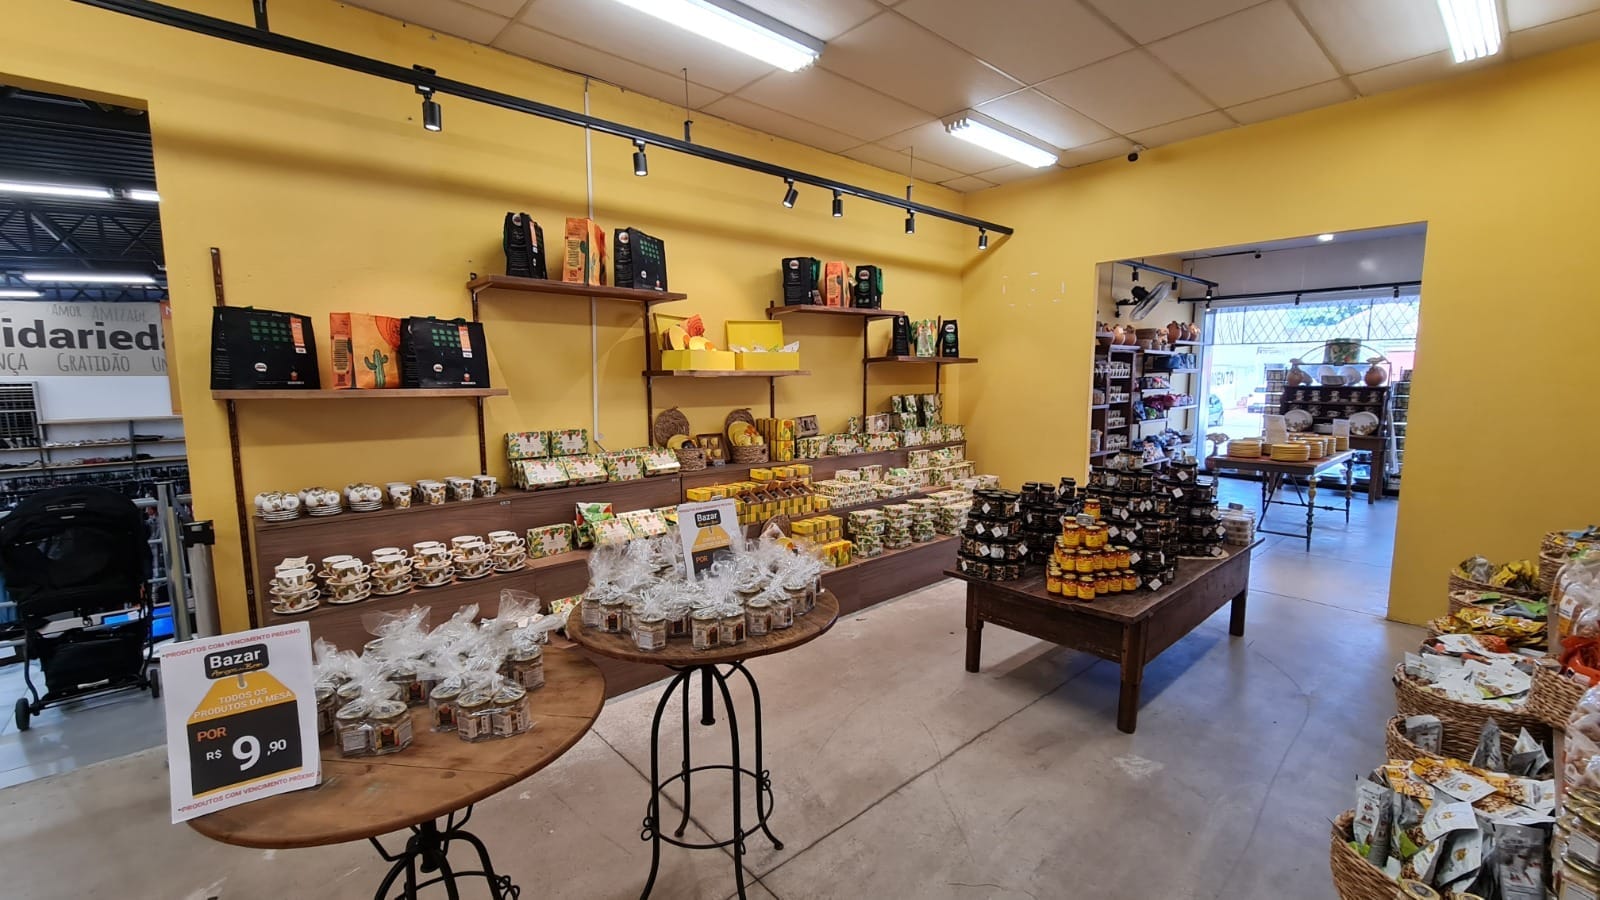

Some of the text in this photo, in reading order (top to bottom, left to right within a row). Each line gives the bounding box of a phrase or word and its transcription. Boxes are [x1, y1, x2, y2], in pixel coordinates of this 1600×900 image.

[2, 318, 165, 350] idaried
[57, 352, 130, 372] GRATIDÃO
[696, 512, 718, 522] Bazar
[208, 642, 225, 651] COM
[225, 632, 270, 647] VENCIMENTO
[209, 649, 262, 669] Bazar
[193, 690, 293, 719] PRODUTOS DA MESA
[219, 687, 268, 705] TODOS OS
[197, 726, 227, 743] POR
[206, 749, 222, 761] R$
[232, 735, 261, 771] 9
[225, 790, 242, 799] COM
[244, 778, 288, 795] VENCIMENTO
